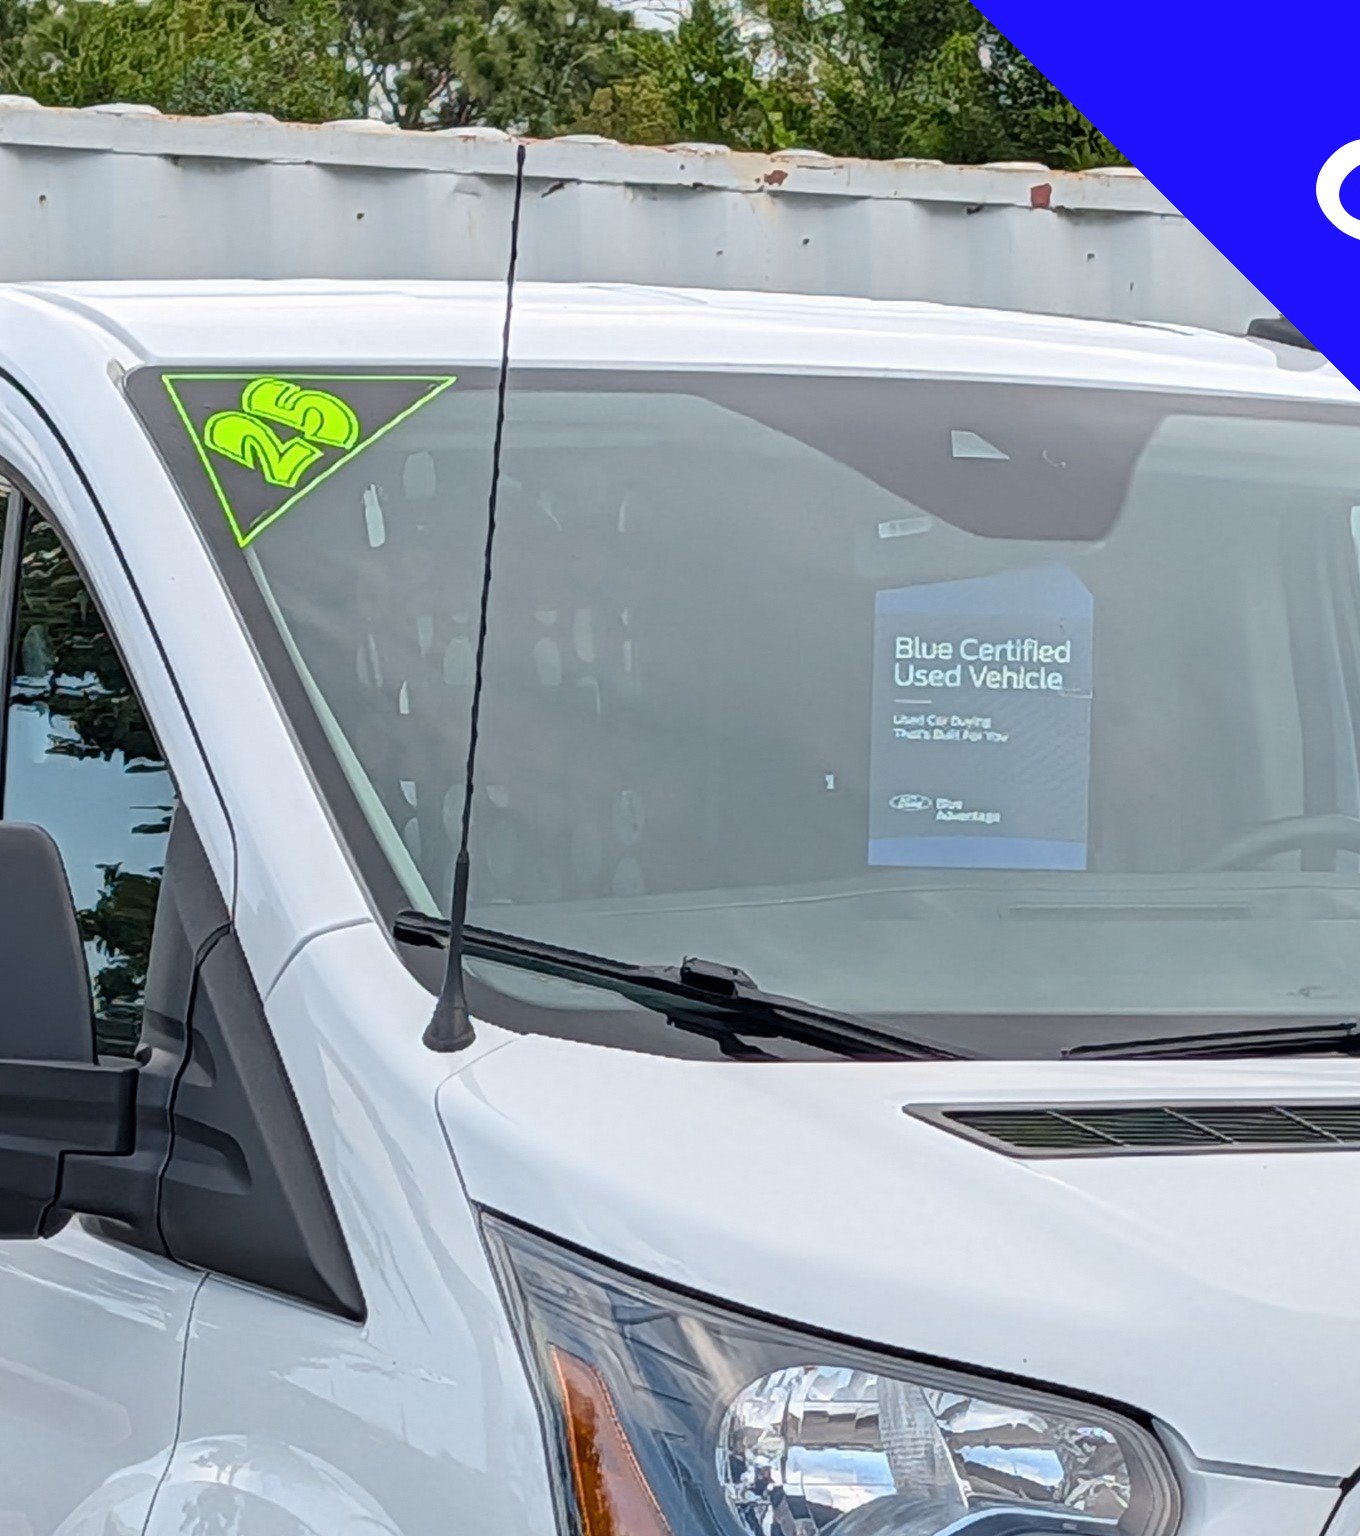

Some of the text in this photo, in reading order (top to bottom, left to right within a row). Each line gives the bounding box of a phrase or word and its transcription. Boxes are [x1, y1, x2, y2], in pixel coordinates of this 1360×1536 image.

[203, 377, 361, 489] 25
[895, 636, 1072, 663] Blue Certified
[894, 662, 1064, 690] Used Vehicle
